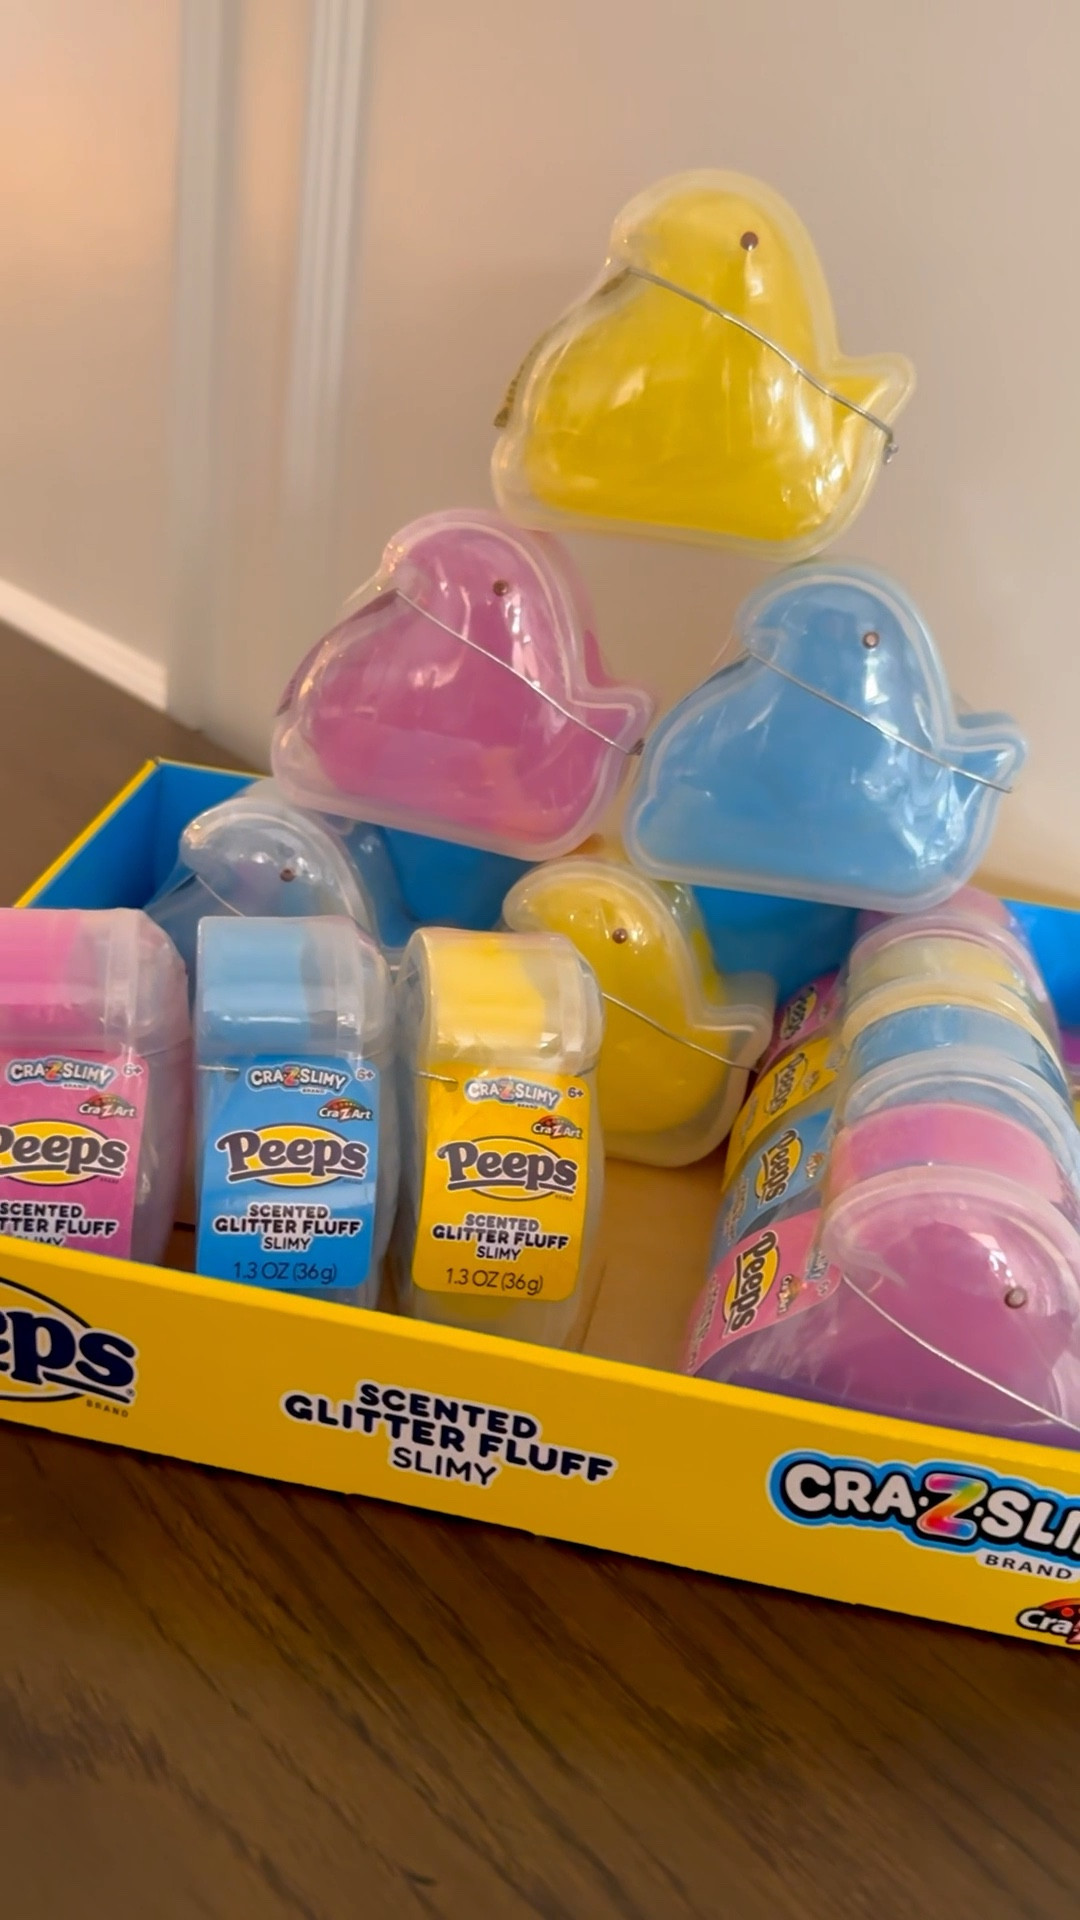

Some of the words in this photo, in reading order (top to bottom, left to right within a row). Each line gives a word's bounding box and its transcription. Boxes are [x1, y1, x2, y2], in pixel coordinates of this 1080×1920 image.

[123, 1064, 141, 1078] 6+
[356, 1068, 374, 1080] 6+
[568, 1087, 584, 1098] 6+
[217, 1131, 367, 1177] Peeps
[437, 1141, 578, 1191] Peeps
[764, 1130, 798, 1202] Peeps
[0, 1202, 83, 1218] SCENTED
[249, 1204, 329, 1219] SCENTED
[55, 1220, 117, 1236] FLUFF
[215, 1218, 297, 1234] GLITTER
[302, 1220, 361, 1235] FLUFF
[465, 1213, 539, 1232] SCENTED
[263, 1236, 311, 1250] SLIMY
[433, 1225, 509, 1245] GLITTER
[514, 1232, 569, 1249] FLUFF
[477, 1245, 521, 1261] SLIMY
[234, 1261, 258, 1280] 1.3
[261, 1262, 290, 1280] OZ
[293, 1262, 337, 1285] (36g)
[446, 1268, 469, 1285] 1.3
[472, 1269, 499, 1288] OZ
[501, 1272, 544, 1296] (36g)
[730, 1231, 777, 1332] Peeps
[86, 1399, 129, 1418] BRAND
[359, 1383, 537, 1439] SCENTED
[285, 1394, 465, 1452] GLITTER
[479, 1433, 613, 1481] FLUFF
[393, 1447, 496, 1486] SLIMY
[984, 1553, 1073, 1580] BRAND
